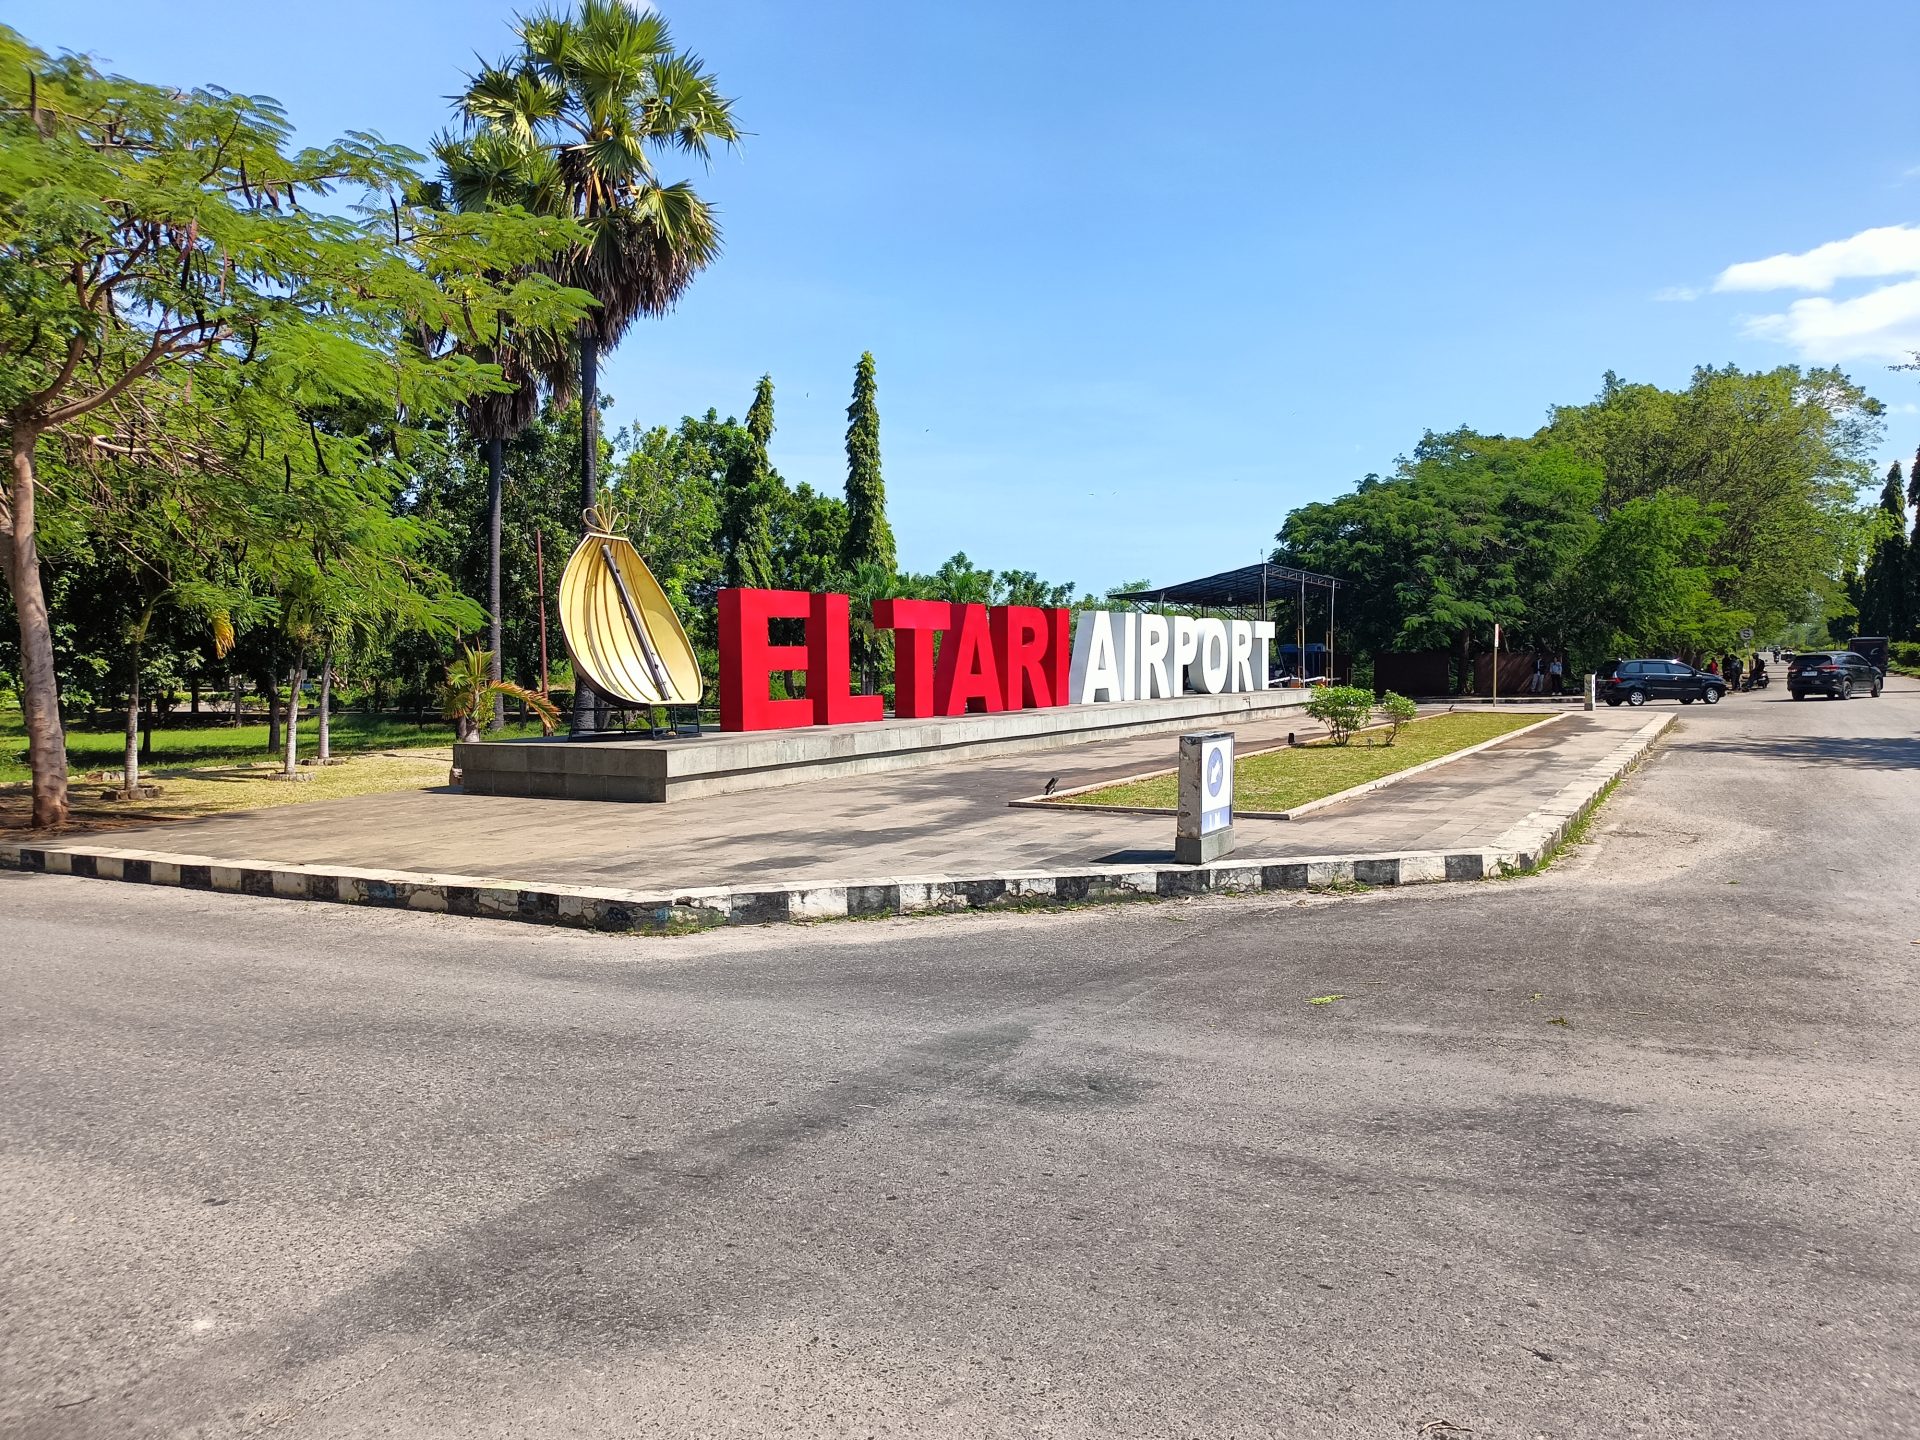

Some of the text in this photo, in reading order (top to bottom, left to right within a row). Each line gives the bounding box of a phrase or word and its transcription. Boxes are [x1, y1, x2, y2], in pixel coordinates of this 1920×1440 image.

[717, 588, 1276, 733] EL TARI AIRPORT
